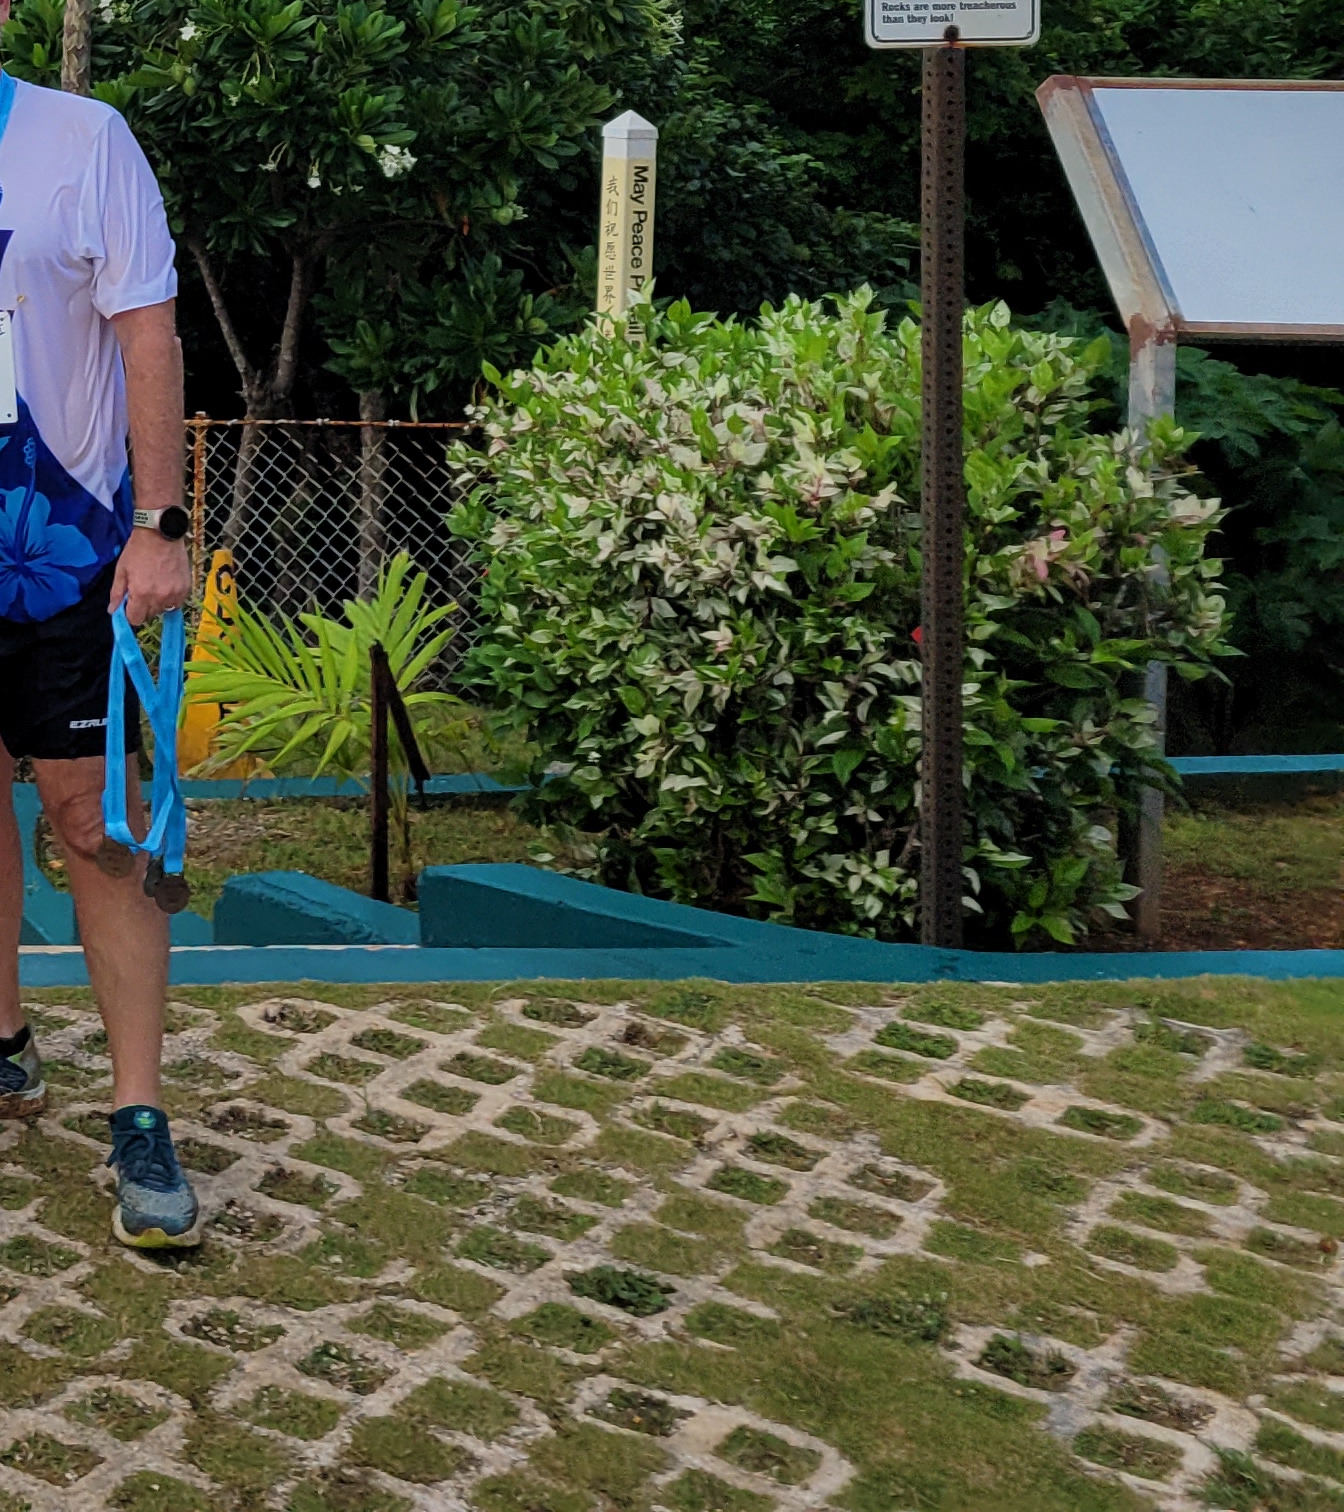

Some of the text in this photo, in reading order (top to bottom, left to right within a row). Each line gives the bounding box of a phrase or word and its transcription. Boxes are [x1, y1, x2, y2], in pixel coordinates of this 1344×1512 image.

[882, 2, 911, 11] Rocks
[913, 3, 929, 11] are
[932, 3, 956, 11] more
[882, 14, 904, 24] than
[907, 14, 928, 24] they
[630, 165, 650, 205] May
[630, 210, 648, 269] Peace
